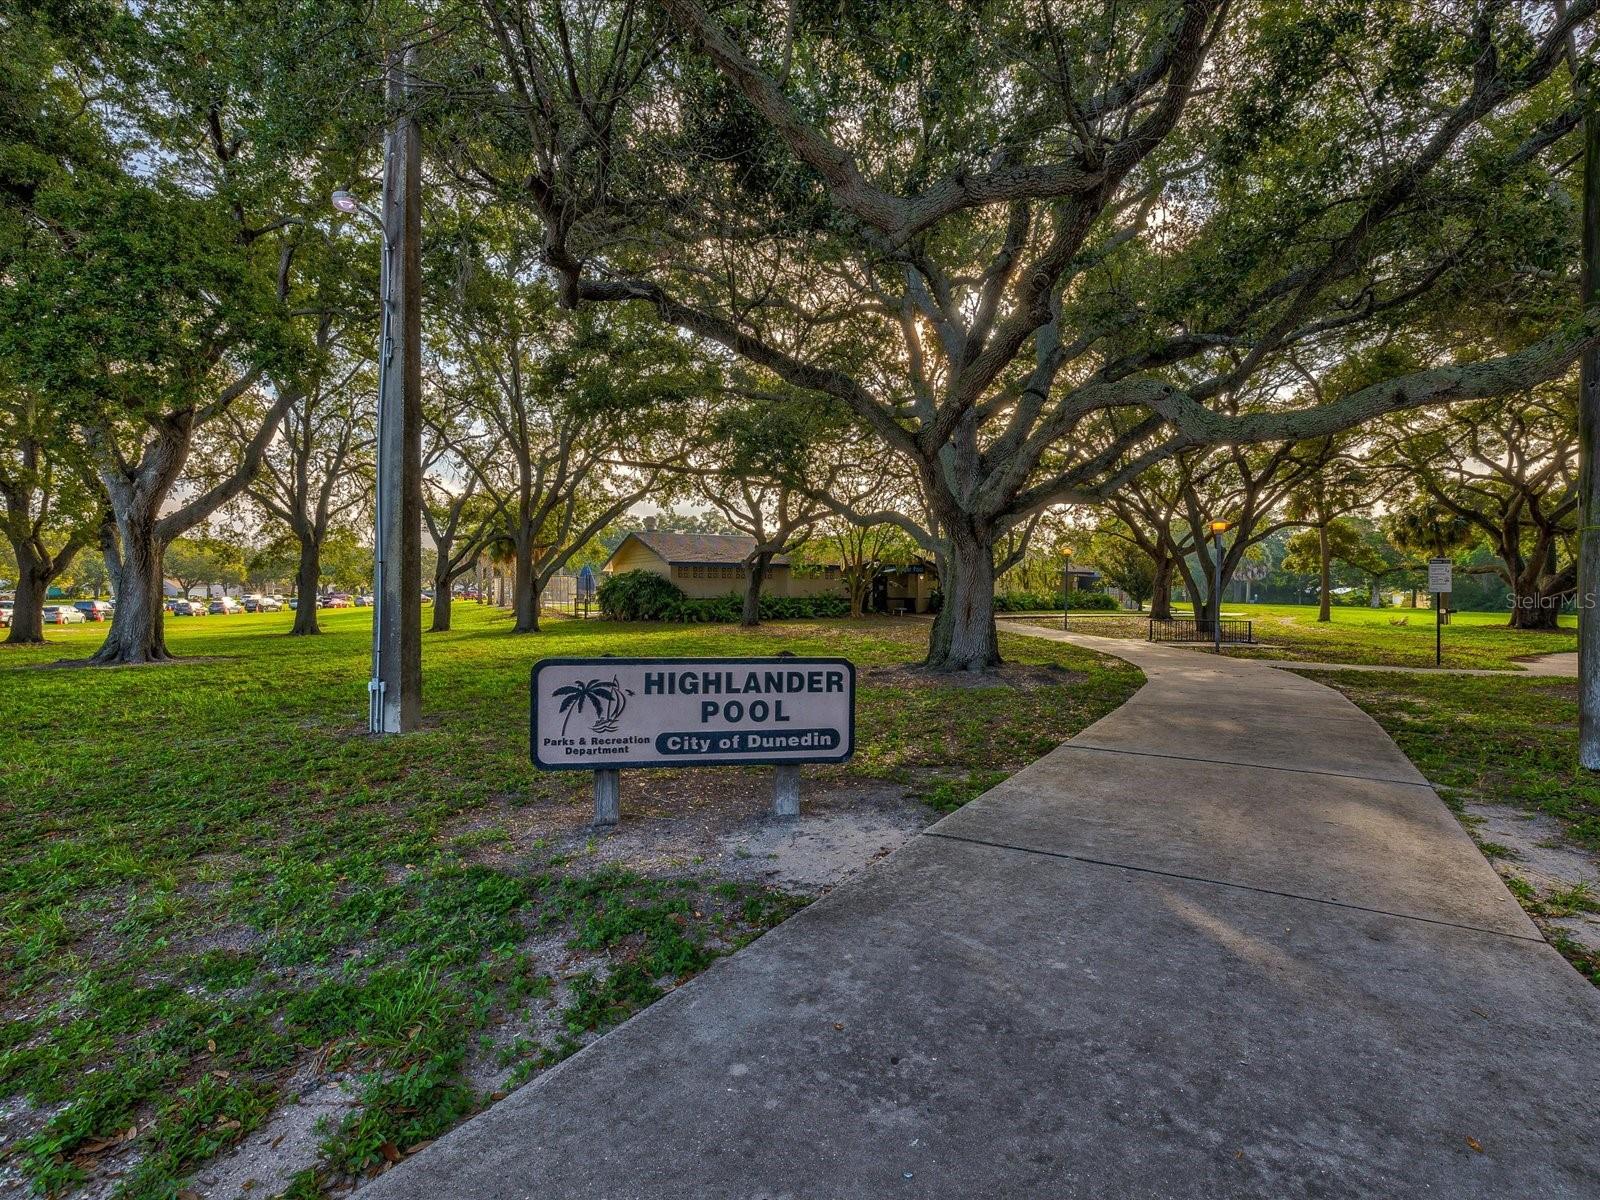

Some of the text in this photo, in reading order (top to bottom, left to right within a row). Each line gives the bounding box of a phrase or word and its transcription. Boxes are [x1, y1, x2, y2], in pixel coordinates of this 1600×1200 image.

[644, 671, 844, 695] HIGHLANDER
[701, 700, 790, 723] POOL
[543, 738, 575, 746] Parks
[590, 735, 650, 745] Recreation
[666, 732, 832, 751] City of Dunedin
[565, 746, 629, 756] Department
